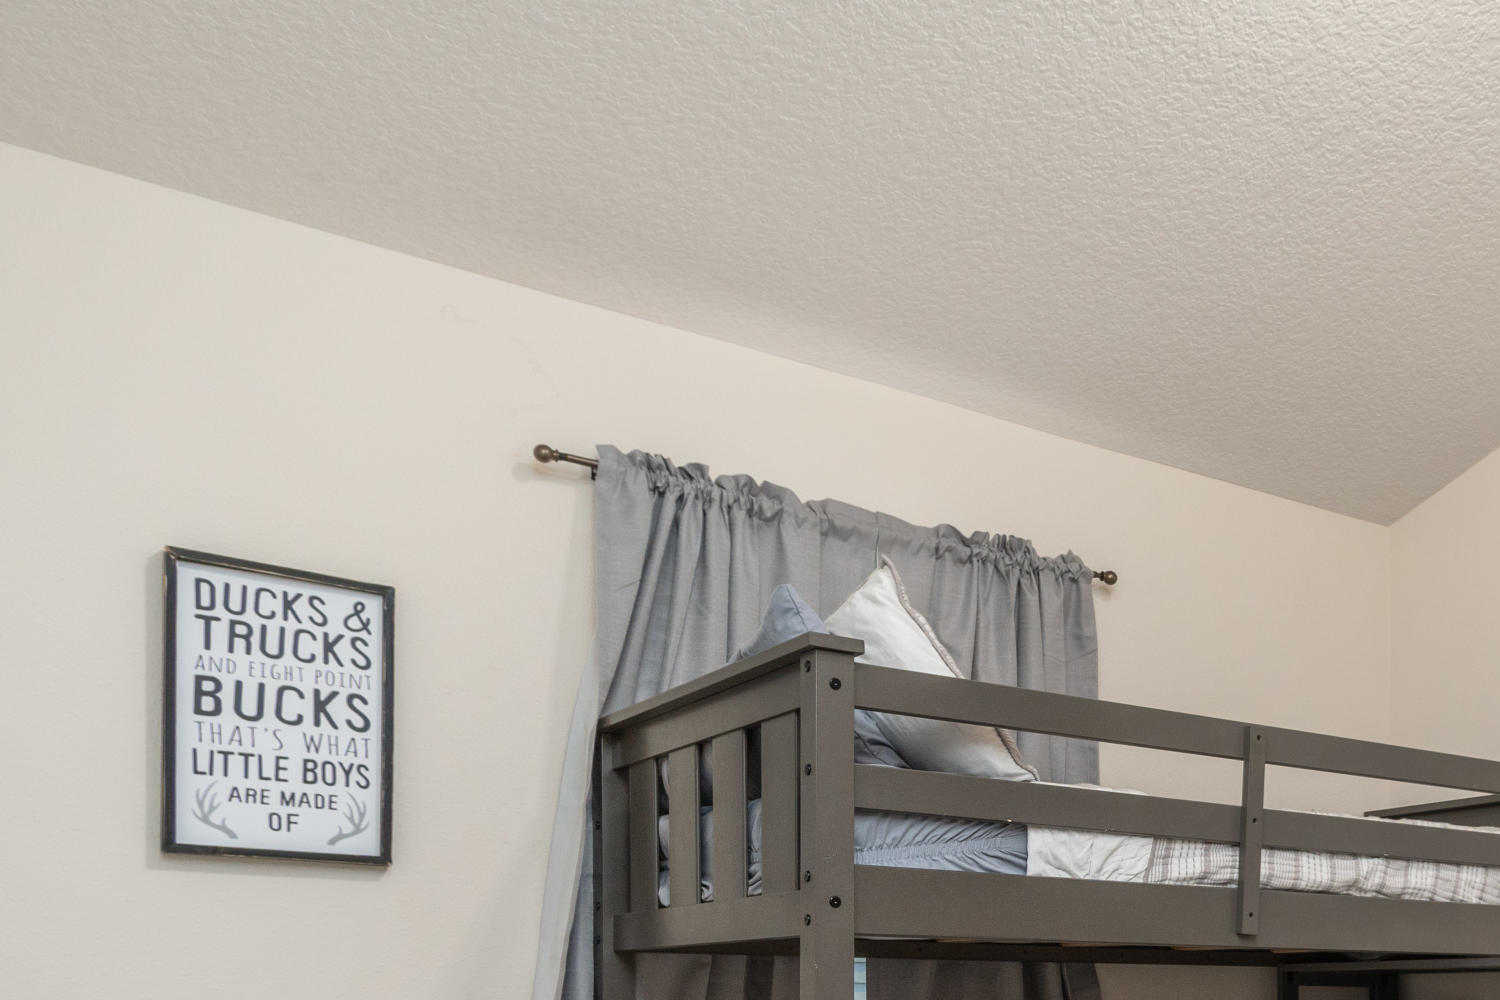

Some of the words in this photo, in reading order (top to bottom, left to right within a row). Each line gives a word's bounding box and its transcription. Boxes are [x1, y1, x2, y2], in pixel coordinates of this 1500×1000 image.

[194, 577, 328, 628] DUCKS
[343, 602, 372, 635] &
[194, 614, 372, 671] TRUCKS
[194, 654, 237, 674] AND
[248, 661, 304, 683] EIGHT
[315, 669, 372, 690] POINT
[193, 674, 372, 733] BUCKS
[194, 720, 284, 751] THAT'S
[302, 732, 371, 759] WHAT
[192, 748, 290, 783] LITTLE
[302, 758, 371, 790] BOYS
[228, 786, 271, 805] ARE
[280, 790, 339, 811] MADE
[268, 812, 300, 832] OF
